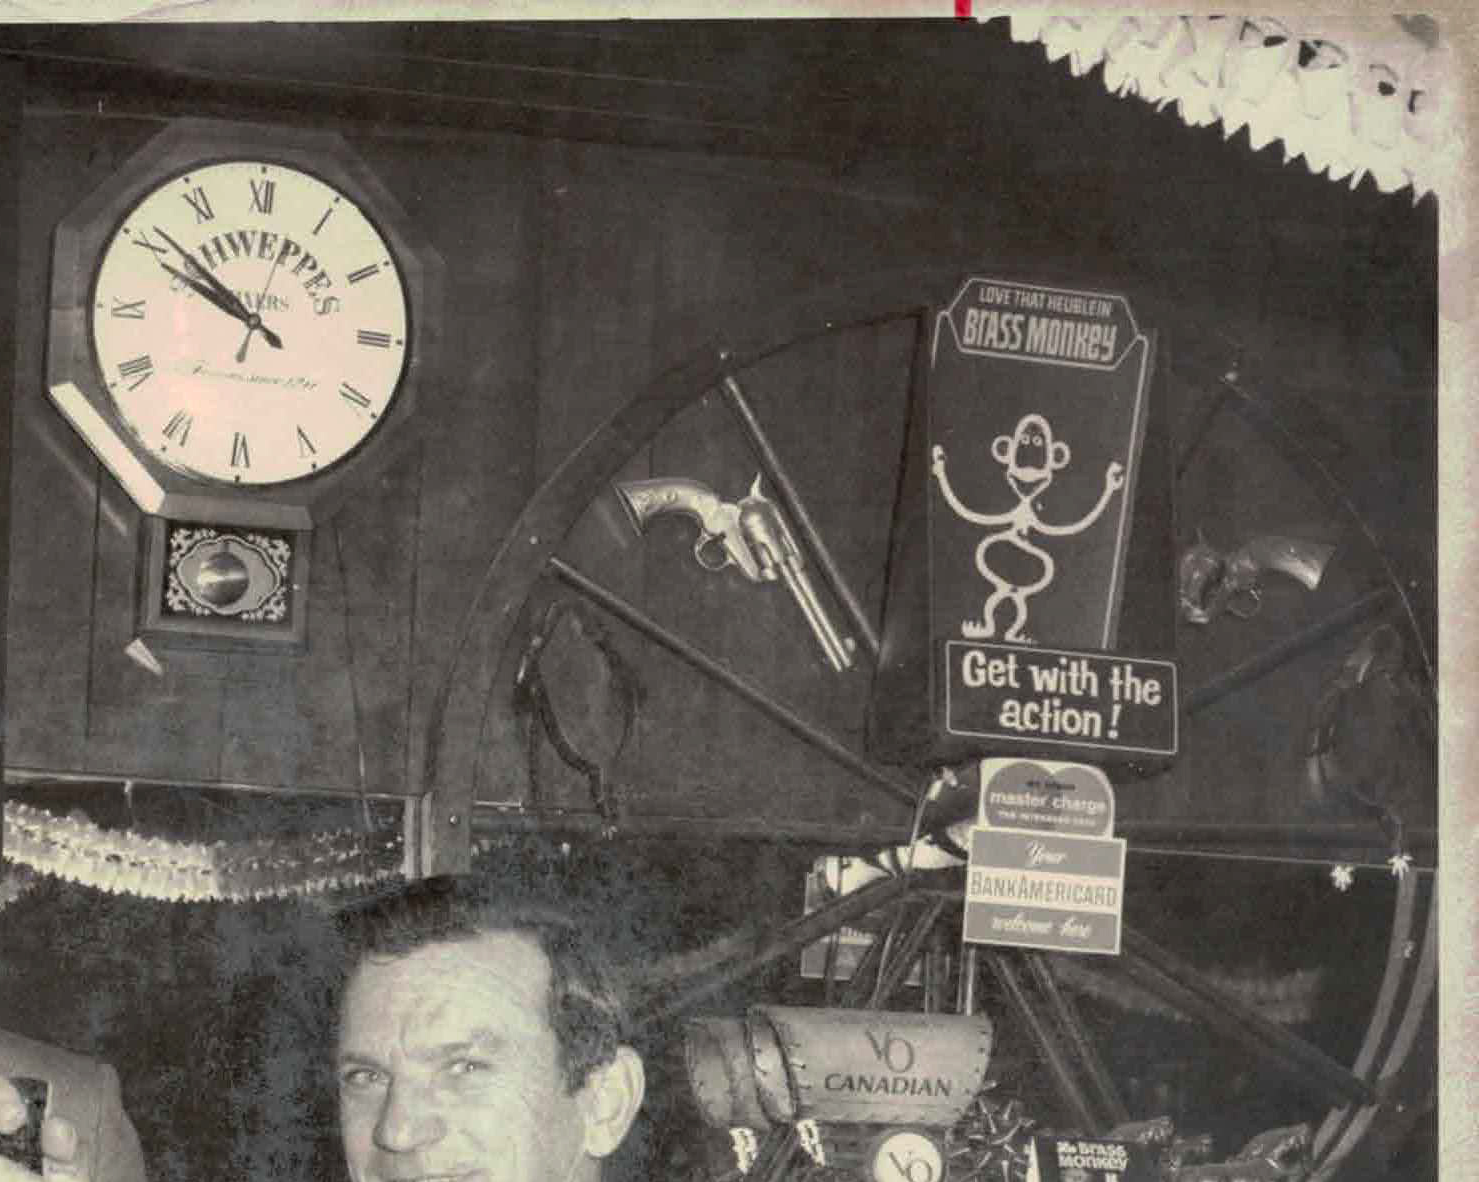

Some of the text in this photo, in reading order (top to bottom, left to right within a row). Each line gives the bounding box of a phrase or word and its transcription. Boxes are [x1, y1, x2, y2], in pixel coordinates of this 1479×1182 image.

[170, 229, 341, 316] HWEPPES
[978, 286, 1113, 317] LOVE THAT HEUBLEIN
[961, 650, 1163, 706] Get with the
[864, 1029, 915, 1074] VO
[824, 1072, 953, 1097] CANADIAN
